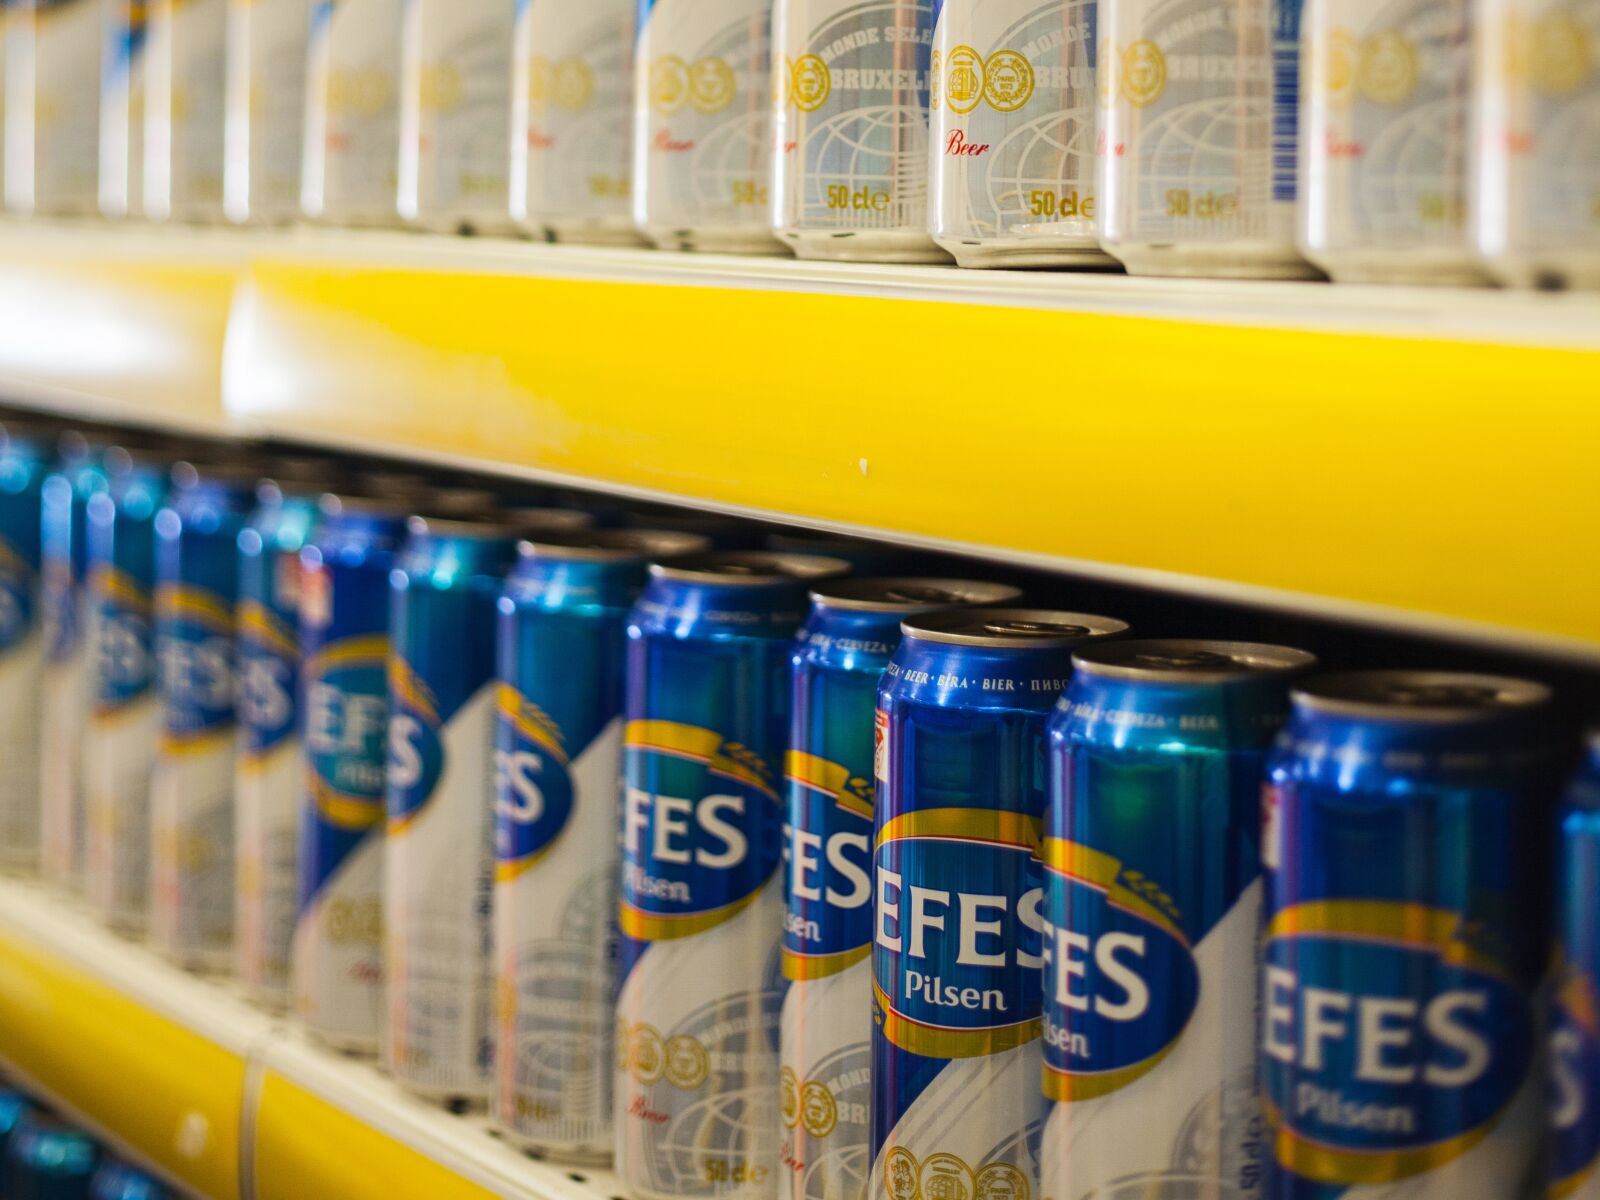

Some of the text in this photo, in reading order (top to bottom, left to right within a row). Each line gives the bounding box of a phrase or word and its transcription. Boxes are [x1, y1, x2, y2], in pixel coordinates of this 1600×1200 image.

[819, 26, 932, 65] MONDE SELE
[830, 68, 930, 91] BRUXEL
[946, 128, 990, 156] Beer
[827, 185, 848, 210] 50
[1031, 189, 1055, 217] 50
[904, 669, 928, 685] BEER
[982, 678, 1015, 691] BIER
[624, 788, 748, 870] FES
[783, 823, 872, 909] ES
[905, 970, 1007, 1012] Pilsen
[1263, 965, 1492, 1087] EFES
[827, 1067, 870, 1096] MOND
